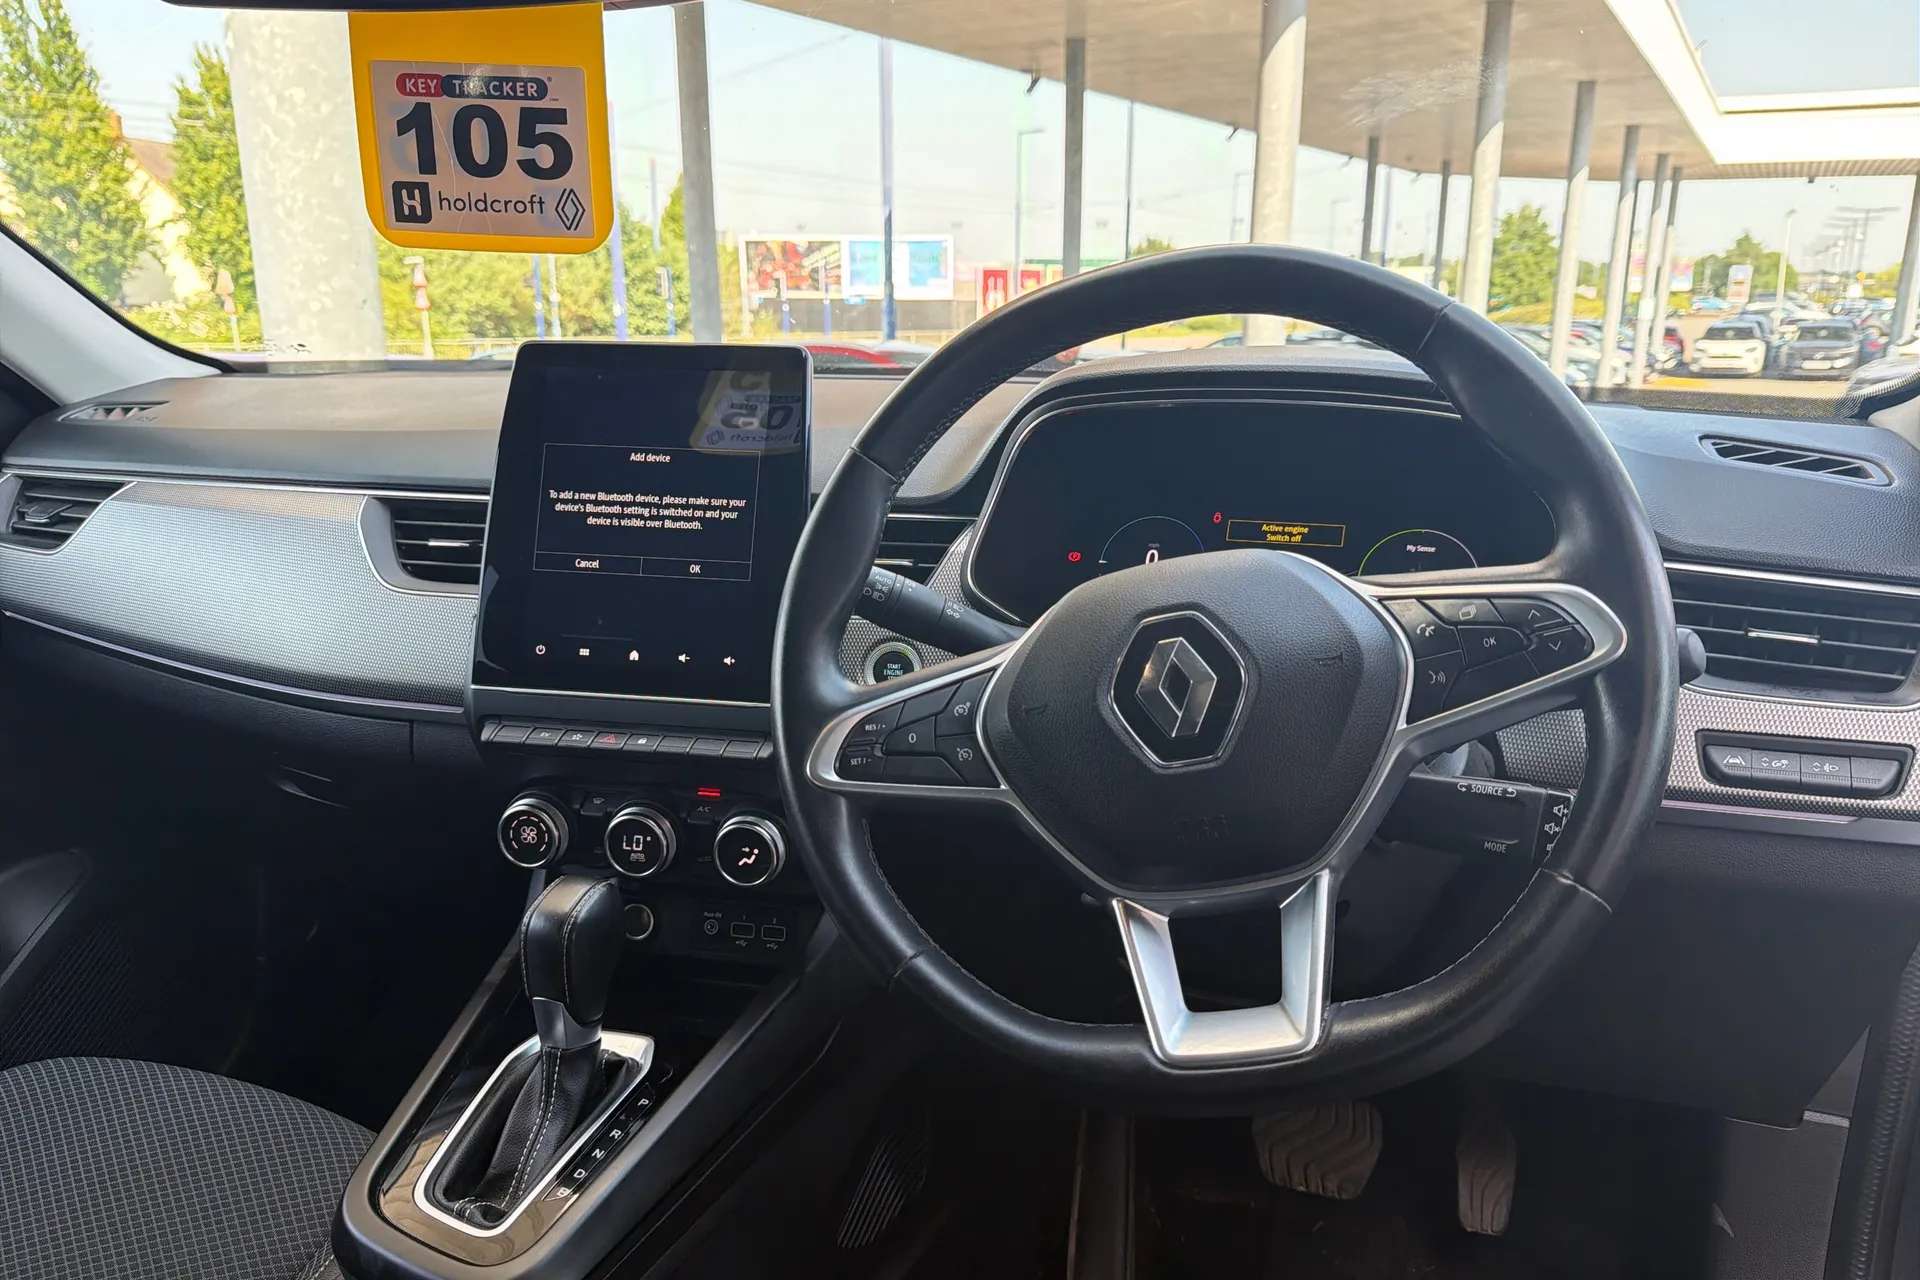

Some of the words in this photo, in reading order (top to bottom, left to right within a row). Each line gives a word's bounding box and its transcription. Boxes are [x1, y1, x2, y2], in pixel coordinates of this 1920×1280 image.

[405, 78, 438, 94] KEY
[452, 79, 538, 97] TRACKER
[396, 101, 573, 181] 105
[438, 191, 545, 214] holdcroft
[630, 452, 645, 462] Add
[646, 453, 671, 463] device
[549, 489, 558, 499] To
[559, 490, 574, 500] add
[579, 493, 597, 501] new
[597, 491, 634, 503] Bluetooth
[634, 493, 661, 505] device,
[662, 495, 687, 506] please
[688, 496, 709, 506] make
[710, 498, 728, 506] sure
[728, 498, 746, 508] your
[555, 501, 585, 512] device's
[585, 504, 622, 515] Bluetooth
[623, 505, 650, 517] setting
[650, 507, 658, 516] is
[658, 507, 693, 518] switched
[693, 510, 704, 518] on
[705, 509, 720, 519] and
[720, 510, 739, 520] your
[586, 515, 611, 526] device
[612, 517, 619, 526] is
[620, 517, 645, 528] visible
[645, 520, 663, 529] over
[664, 519, 703, 530] Bluetooth.
[1261, 523, 1283, 533] Active
[1283, 525, 1309, 535] engine
[1265, 533, 1290, 543] Switch
[1290, 534, 1302, 543] off
[1406, 544, 1416, 554] My
[1417, 544, 1437, 553] Sense
[1145, 549, 1159, 564] 0
[575, 558, 600, 569] Cancel
[689, 564, 701, 574] OK
[875, 575, 892, 585] AUTO
[1483, 636, 1497, 648] OK
[1470, 785, 1503, 797] SOURCE
[1483, 841, 1507, 853] MODE
[637, 1098, 649, 1107] P
[609, 1129, 622, 1139] R
[591, 1148, 605, 1159] N
[573, 1169, 586, 1178] D
